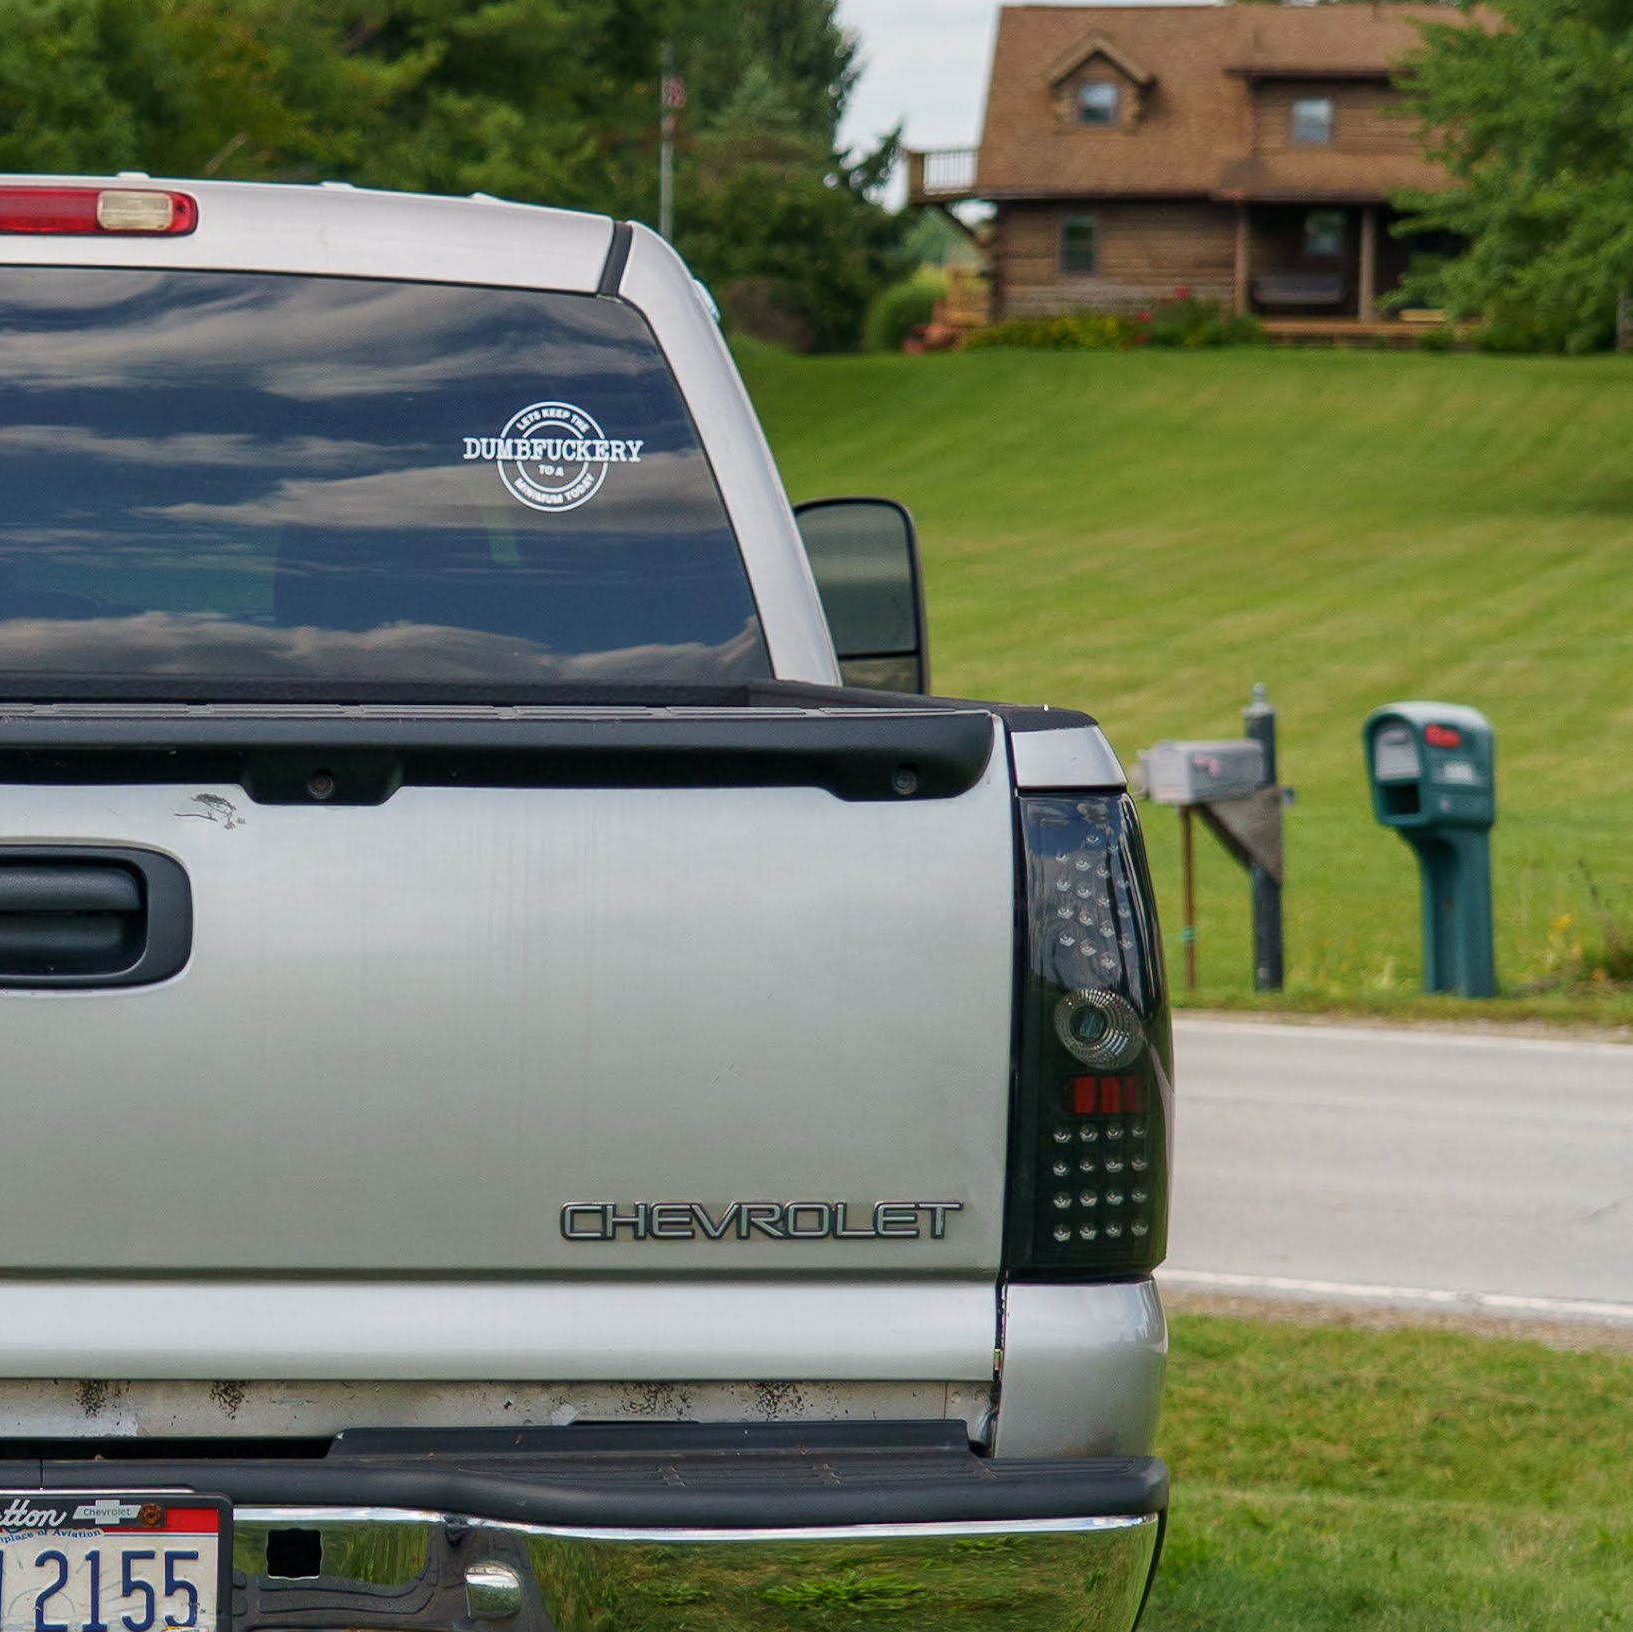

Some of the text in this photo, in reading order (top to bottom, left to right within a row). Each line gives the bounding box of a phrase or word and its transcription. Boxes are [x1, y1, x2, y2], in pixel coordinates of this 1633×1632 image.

[516, 408, 590, 433] LETS KEEP THE
[463, 437, 644, 463] DUMBFUCKERY
[538, 464, 565, 477] TO A
[514, 473, 594, 504] MINIMUM TODAY
[560, 1201, 964, 1239] CHEVROLET
[83, 1507, 131, 1517] Chevrolet
[38, 1529, 48, 1537] of
[52, 1528, 101, 1539] Aviation
[34, 1549, 199, 1632] 2155
